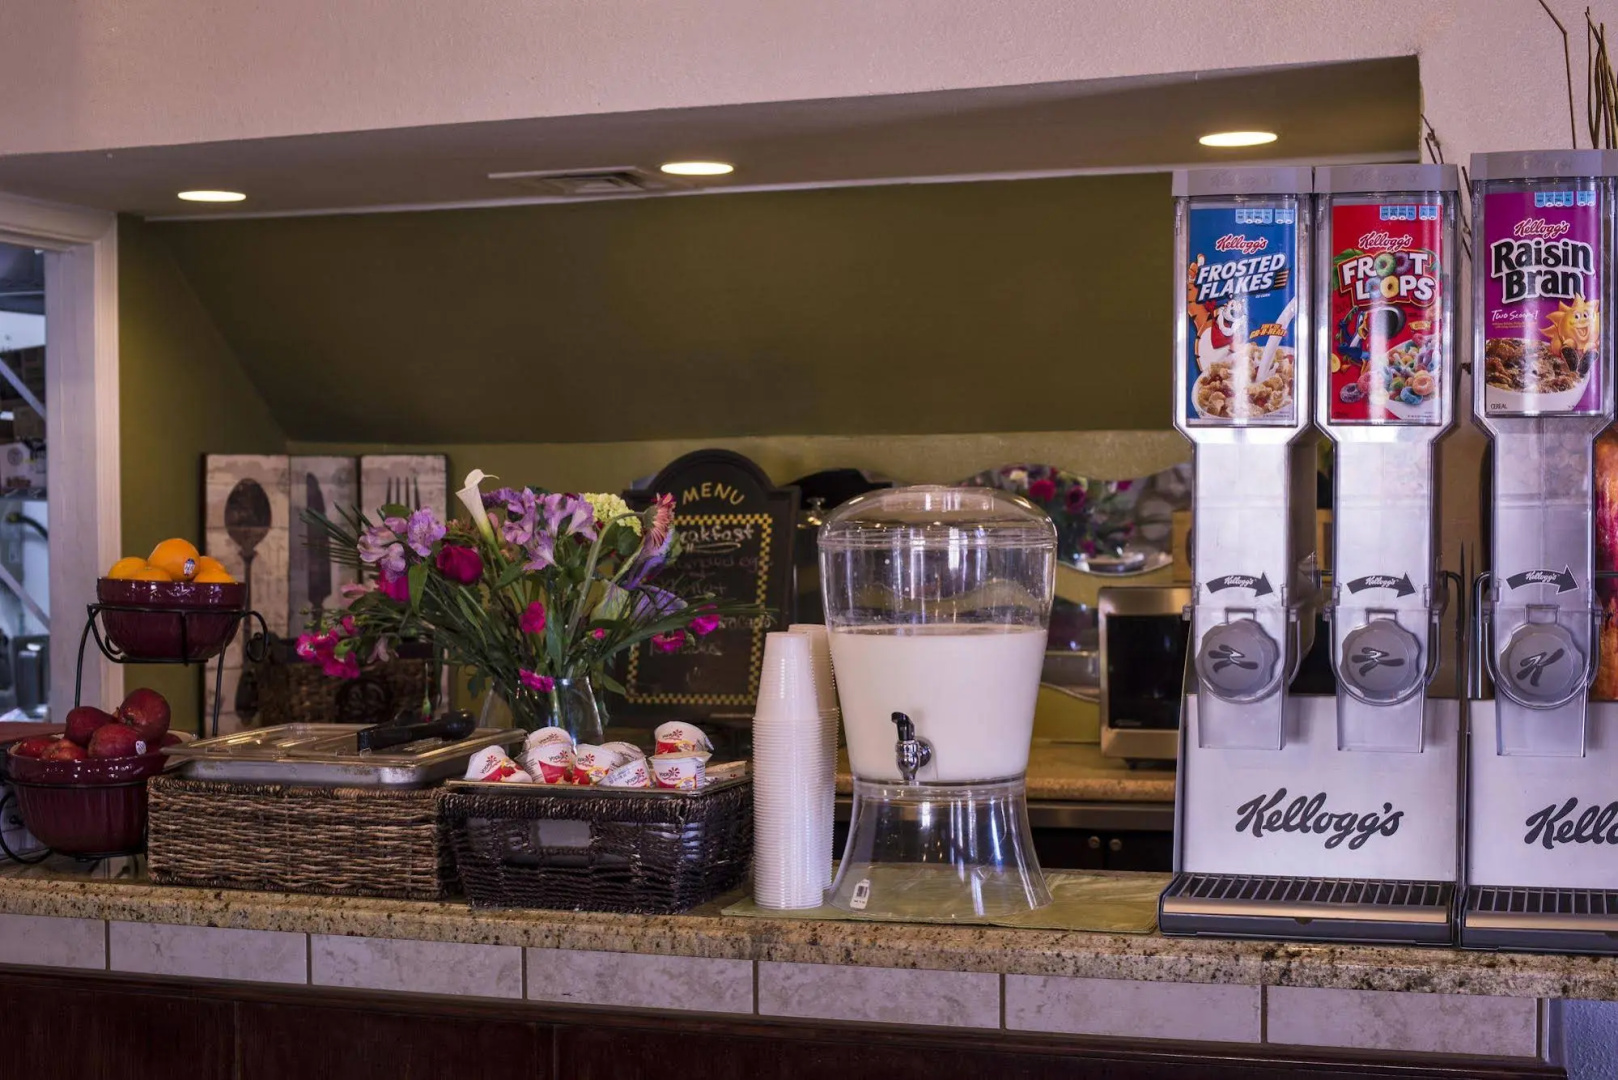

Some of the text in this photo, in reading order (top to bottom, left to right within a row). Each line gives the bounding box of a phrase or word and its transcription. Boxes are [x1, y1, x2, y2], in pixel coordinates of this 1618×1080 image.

[1514, 218, 1570, 239] Kellogg's
[1215, 234, 1268, 254] Kellogg's
[1358, 231, 1413, 252] Kellogg's
[1196, 253, 1286, 285] FROSTED
[1342, 252, 1428, 286] FROOT
[1491, 239, 1594, 277] Raisin
[1197, 272, 1274, 302] FLAKES
[1355, 275, 1435, 301] LOOPS
[1503, 269, 1583, 302] Bran
[682, 482, 745, 506] MENU
[680, 524, 754, 543] eakfast
[1224, 575, 1254, 587] Kellogg's
[1365, 575, 1397, 588] Kellogg's
[1525, 570, 1557, 583] Kellogg's
[1235, 787, 1404, 851] Kellogg's
